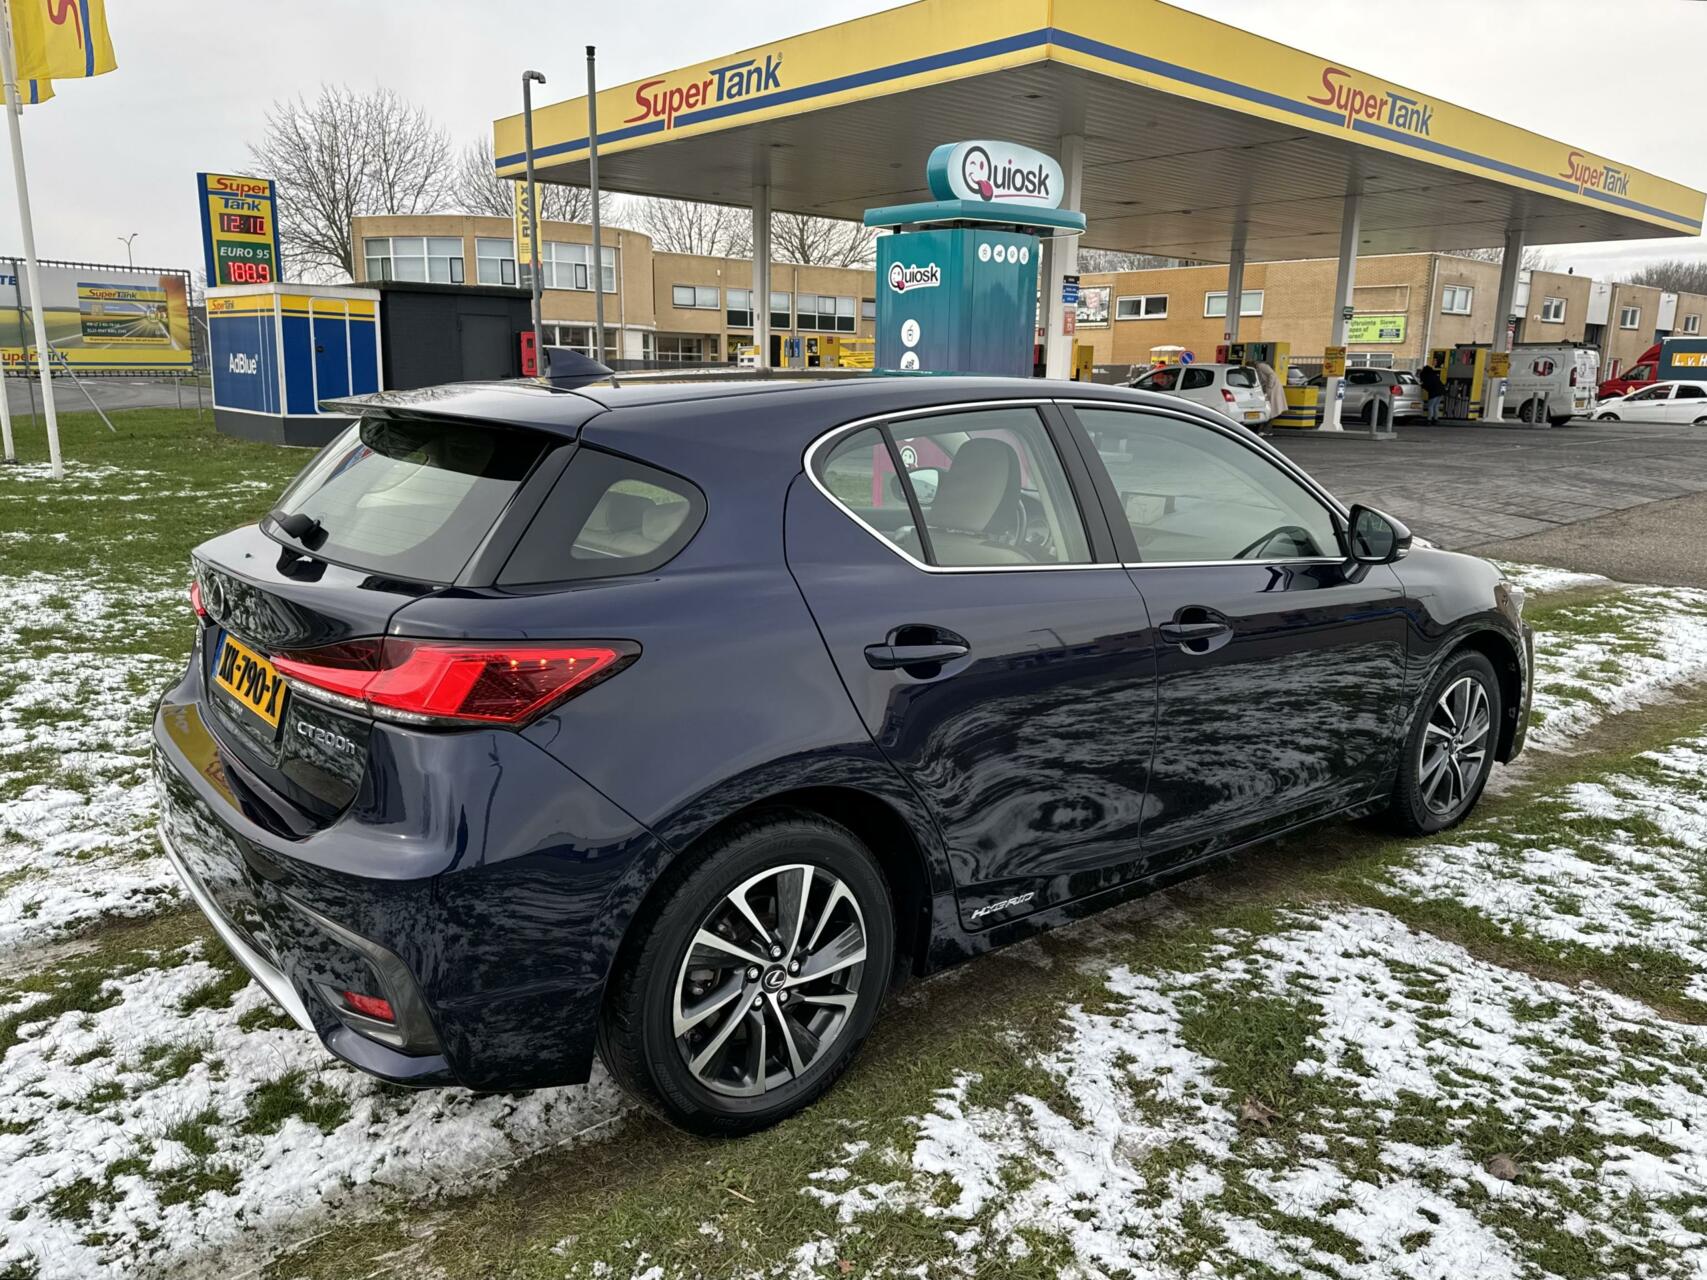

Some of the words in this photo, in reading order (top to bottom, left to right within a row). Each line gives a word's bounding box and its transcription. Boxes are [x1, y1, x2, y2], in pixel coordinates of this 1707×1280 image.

[623, 54, 783, 131] SuperTank
[1307, 67, 1433, 136] SuperTank
[961, 145, 1050, 202] Quiosk
[1558, 151, 1630, 195] SuperTank
[207, 177, 269, 198] Super
[218, 196, 261, 212] Tank
[223, 215, 265, 234] 12:10
[220, 246, 253, 258] EURO
[256, 249, 270, 260] 95
[889, 263, 939, 291] Quiosk
[89, 289, 137, 300] SuperTank
[229, 353, 258, 375] AdBlue
[297, 720, 356, 756] CT200h
